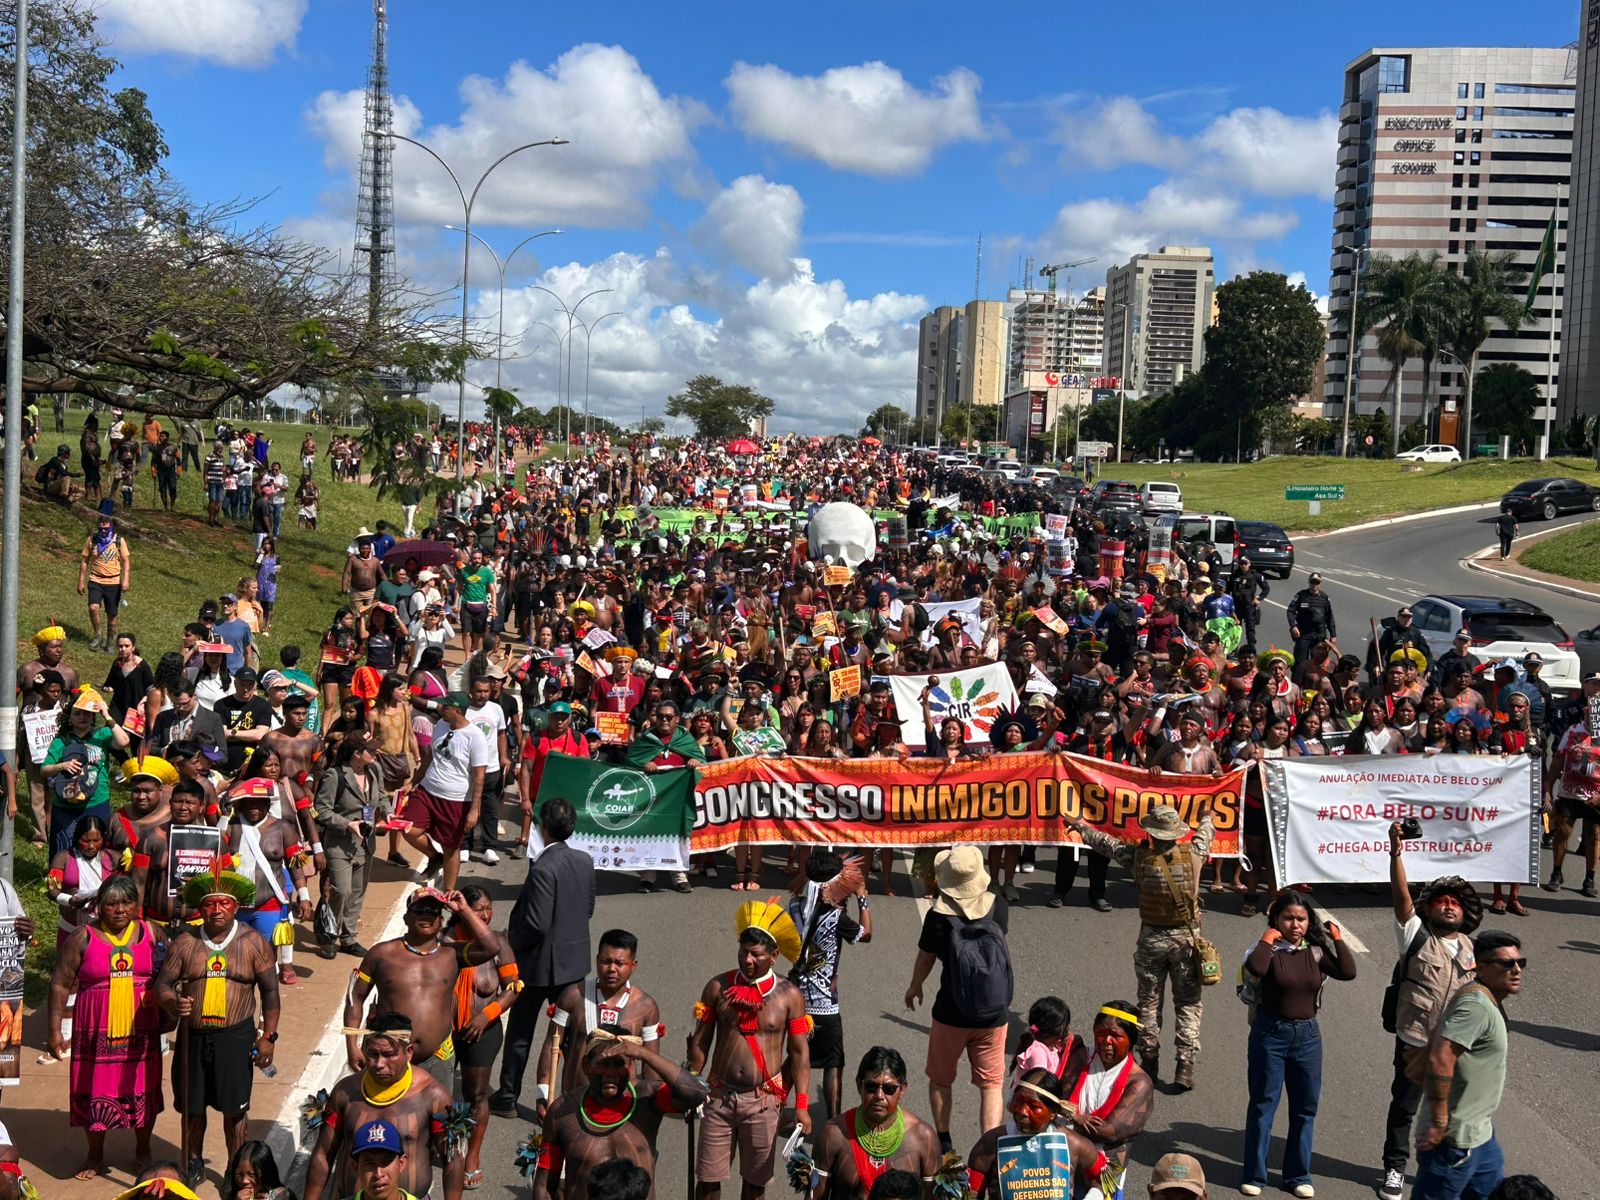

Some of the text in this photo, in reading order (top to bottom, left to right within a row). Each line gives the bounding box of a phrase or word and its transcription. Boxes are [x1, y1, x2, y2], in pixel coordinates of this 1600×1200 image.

[1384, 117, 1453, 131] EXECUTIVE
[1393, 139, 1436, 153] OFFICE
[1391, 162, 1437, 175] TOWER
[1061, 373, 1085, 386] GEAP
[949, 703, 972, 718] CIR
[308, 708, 316, 731] OIAB
[1319, 771, 1503, 785] ANULAÇÃO IMEDIATA DE BELO SUN
[890, 782, 1030, 822] INIMIGO
[1036, 778, 1106, 824] DOS
[605, 804, 634, 812] COIAB
[1316, 803, 1499, 821] #FORA BELO SUN#
[1318, 842, 1370, 854] #CHEGA
[1373, 841, 1389, 852] DE
[1023, 1168, 1051, 1177] POVOS
[1007, 1177, 1067, 1190] INDÍGENAS SÃO
[1013, 1189, 1064, 1200] DEFENSORES
